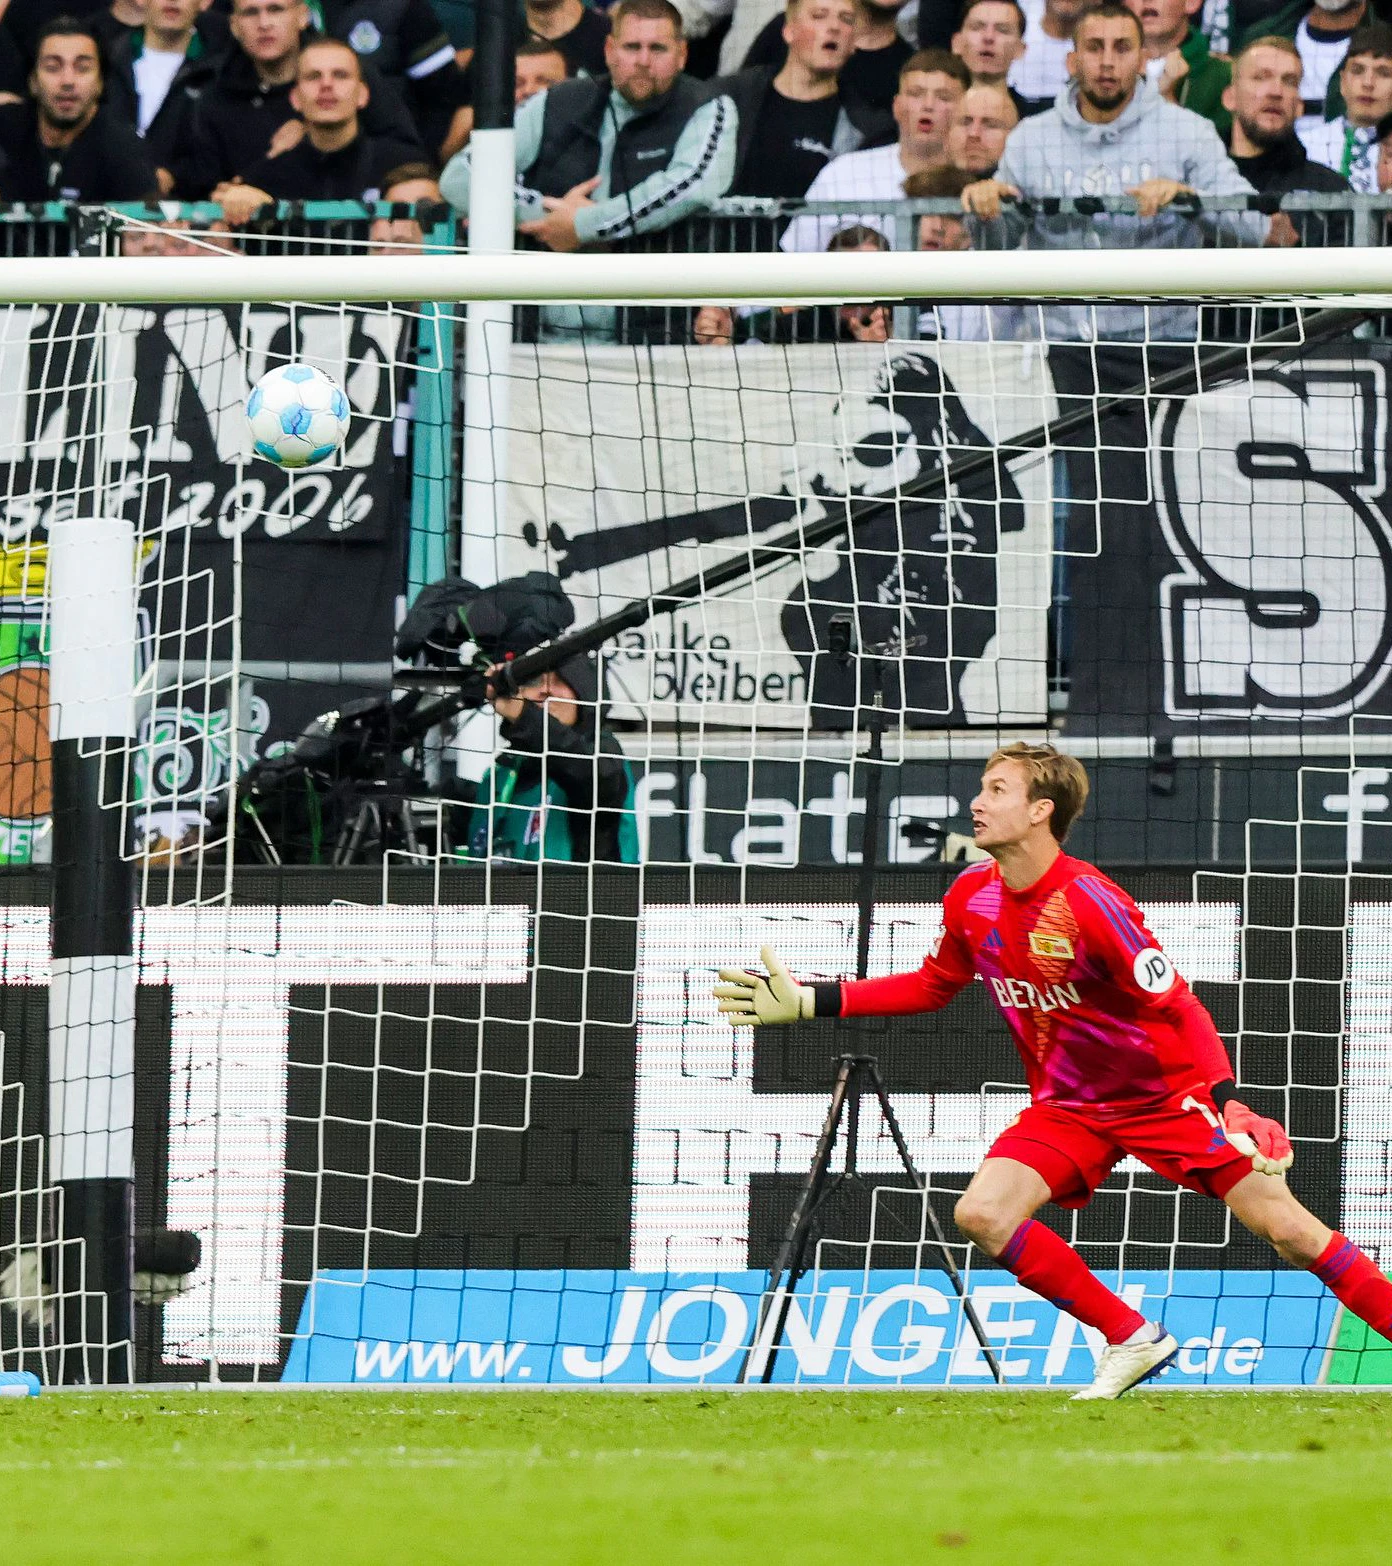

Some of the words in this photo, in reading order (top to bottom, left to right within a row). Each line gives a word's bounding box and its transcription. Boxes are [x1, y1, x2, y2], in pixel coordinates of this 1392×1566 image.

[1144, 955, 1167, 988] JD
[989, 976, 1083, 1013] BERLIN
[354, 1339, 532, 1379] www.
